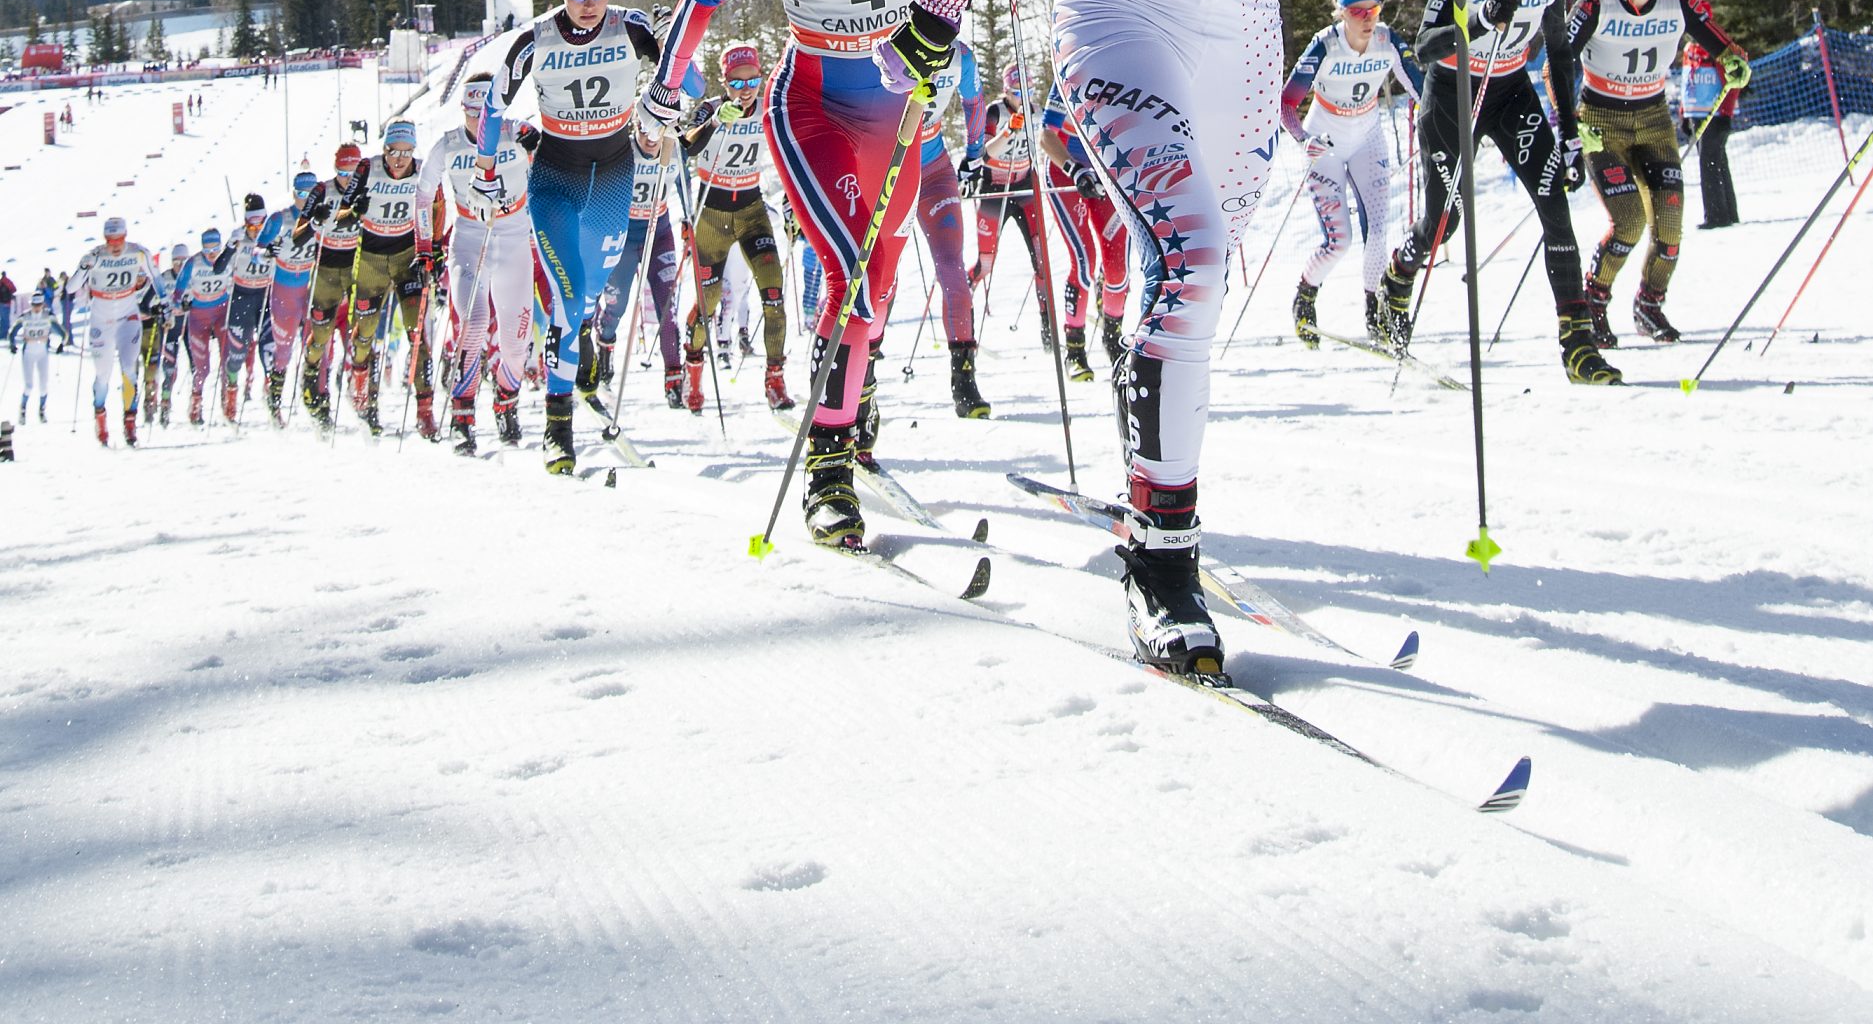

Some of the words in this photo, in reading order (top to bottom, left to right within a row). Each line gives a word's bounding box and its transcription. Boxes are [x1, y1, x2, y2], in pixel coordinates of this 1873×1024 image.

[821, 6, 914, 34] CANMOR
[1601, 18, 1679, 38] AltaGas
[1567, 17, 1584, 44] udi
[540, 44, 628, 71] AltaGas
[727, 51, 755, 65] JOKA
[1622, 46, 1659, 75] 11
[223, 67, 259, 78] CRAFT
[286, 62, 321, 73] AltaGas
[1328, 58, 1391, 76] AltaGas
[563, 75, 611, 109] 12
[1084, 77, 1181, 121] CRAFT
[1351, 82, 1371, 103] 9
[557, 105, 624, 121] CANMORE
[559, 118, 623, 136] VIESSMANN
[724, 142, 760, 168] 24
[1146, 142, 1185, 159] US
[1142, 158, 1163, 170] SKI
[1163, 153, 1189, 165] TEAM
[1309, 171, 1338, 188] RAFT
[379, 201, 410, 219] 18
[290, 244, 316, 260] 28
[100, 256, 138, 268] AltaGas
[537, 230, 574, 300] FINNFORM
[106, 270, 132, 287] 20
[201, 279, 223, 293] 32
